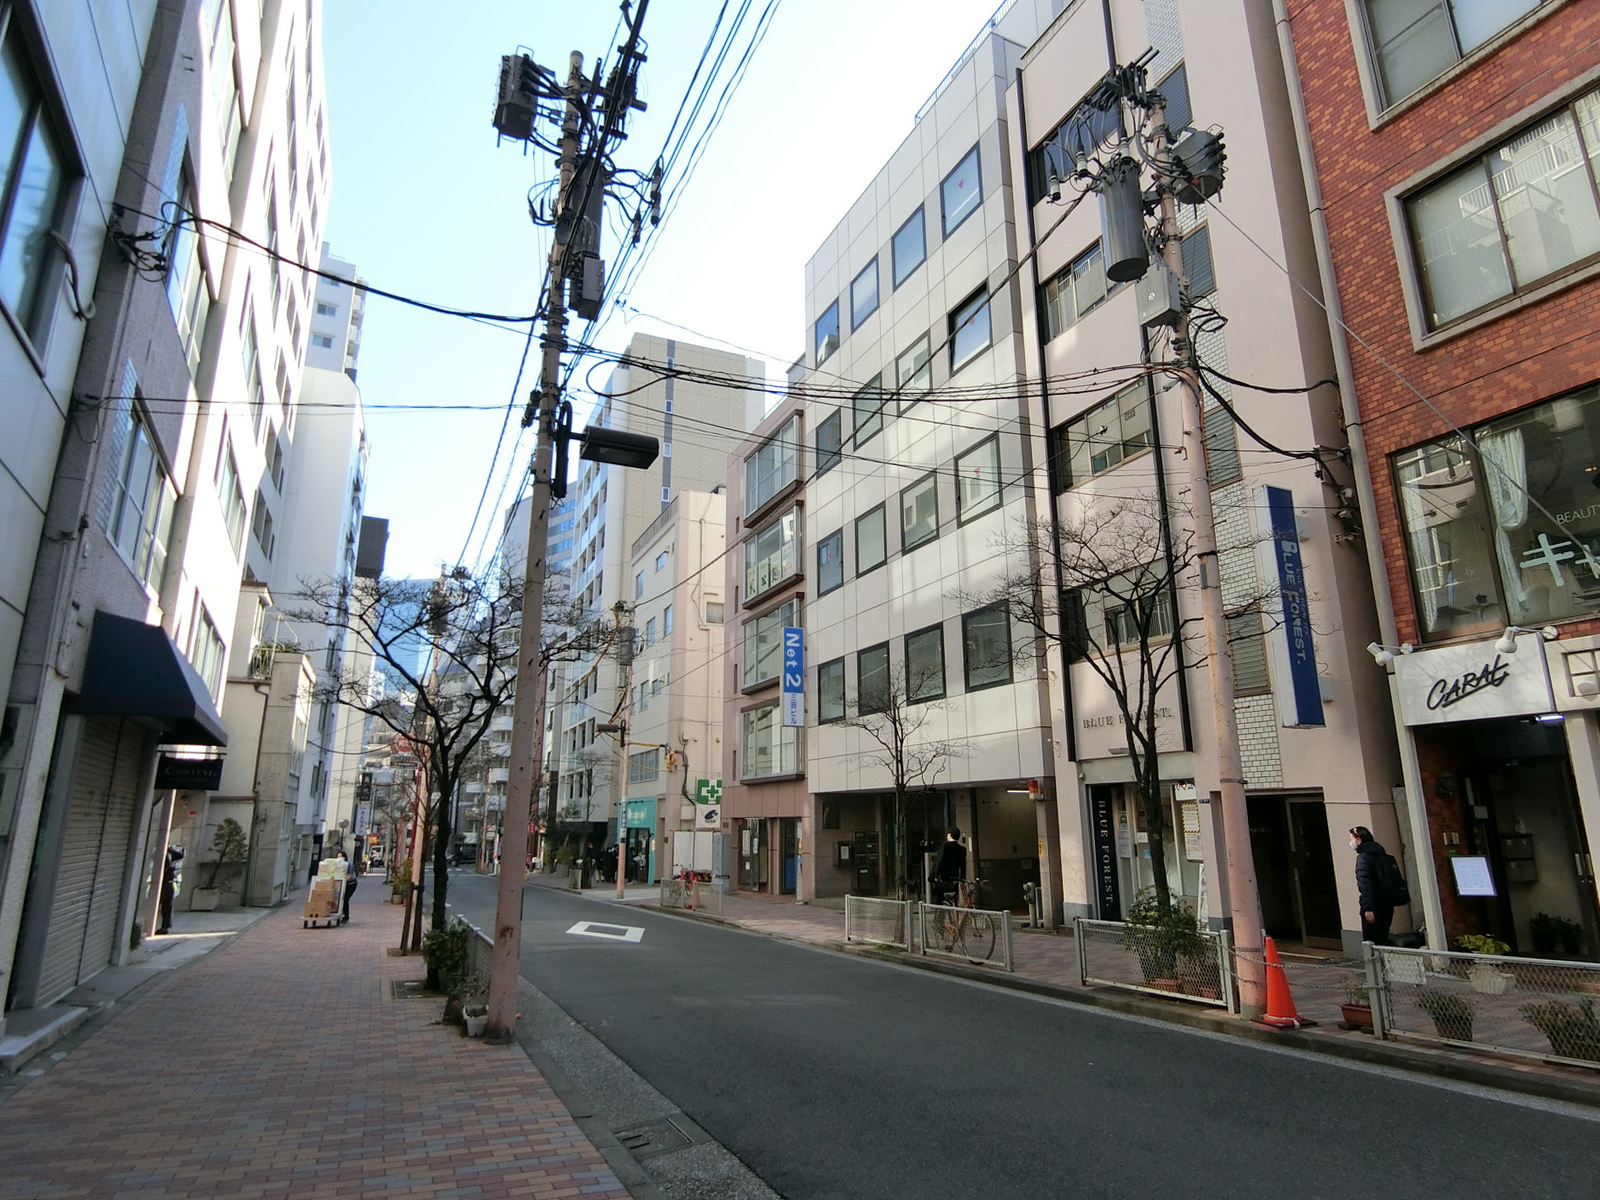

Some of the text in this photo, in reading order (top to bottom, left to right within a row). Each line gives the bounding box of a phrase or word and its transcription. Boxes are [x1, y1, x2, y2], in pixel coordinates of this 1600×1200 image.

[786, 633, 802, 688] Net 2
[1082, 715, 1114, 729] BLUE
[1098, 800, 1114, 907] BLUE FOREST.
